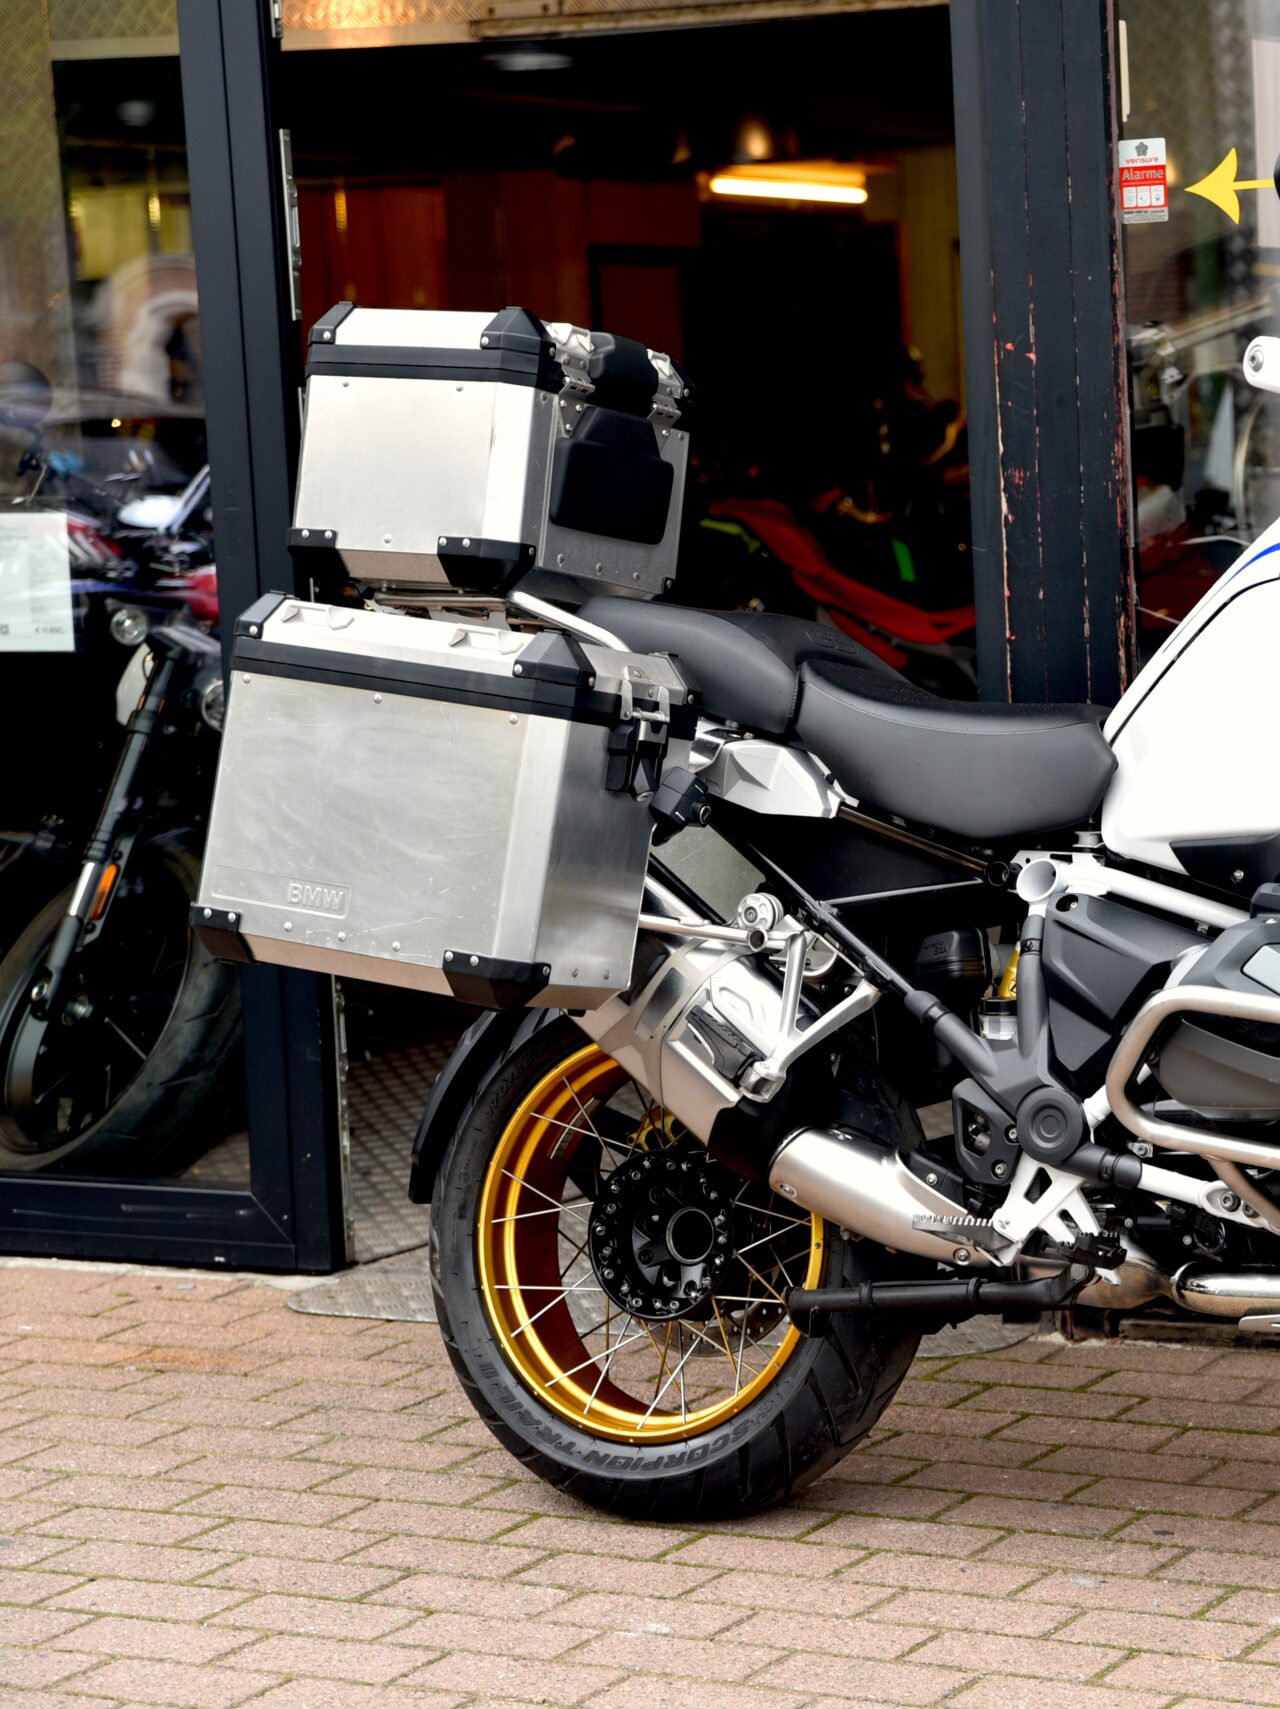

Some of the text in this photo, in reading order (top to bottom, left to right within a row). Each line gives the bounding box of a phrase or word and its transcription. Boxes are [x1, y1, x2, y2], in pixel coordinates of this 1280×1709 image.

[1122, 168, 1164, 181] Alarme
[287, 882, 344, 911] BMW
[495, 1386, 577, 1457] TRAIL
[583, 1416, 752, 1471] SCORPION
